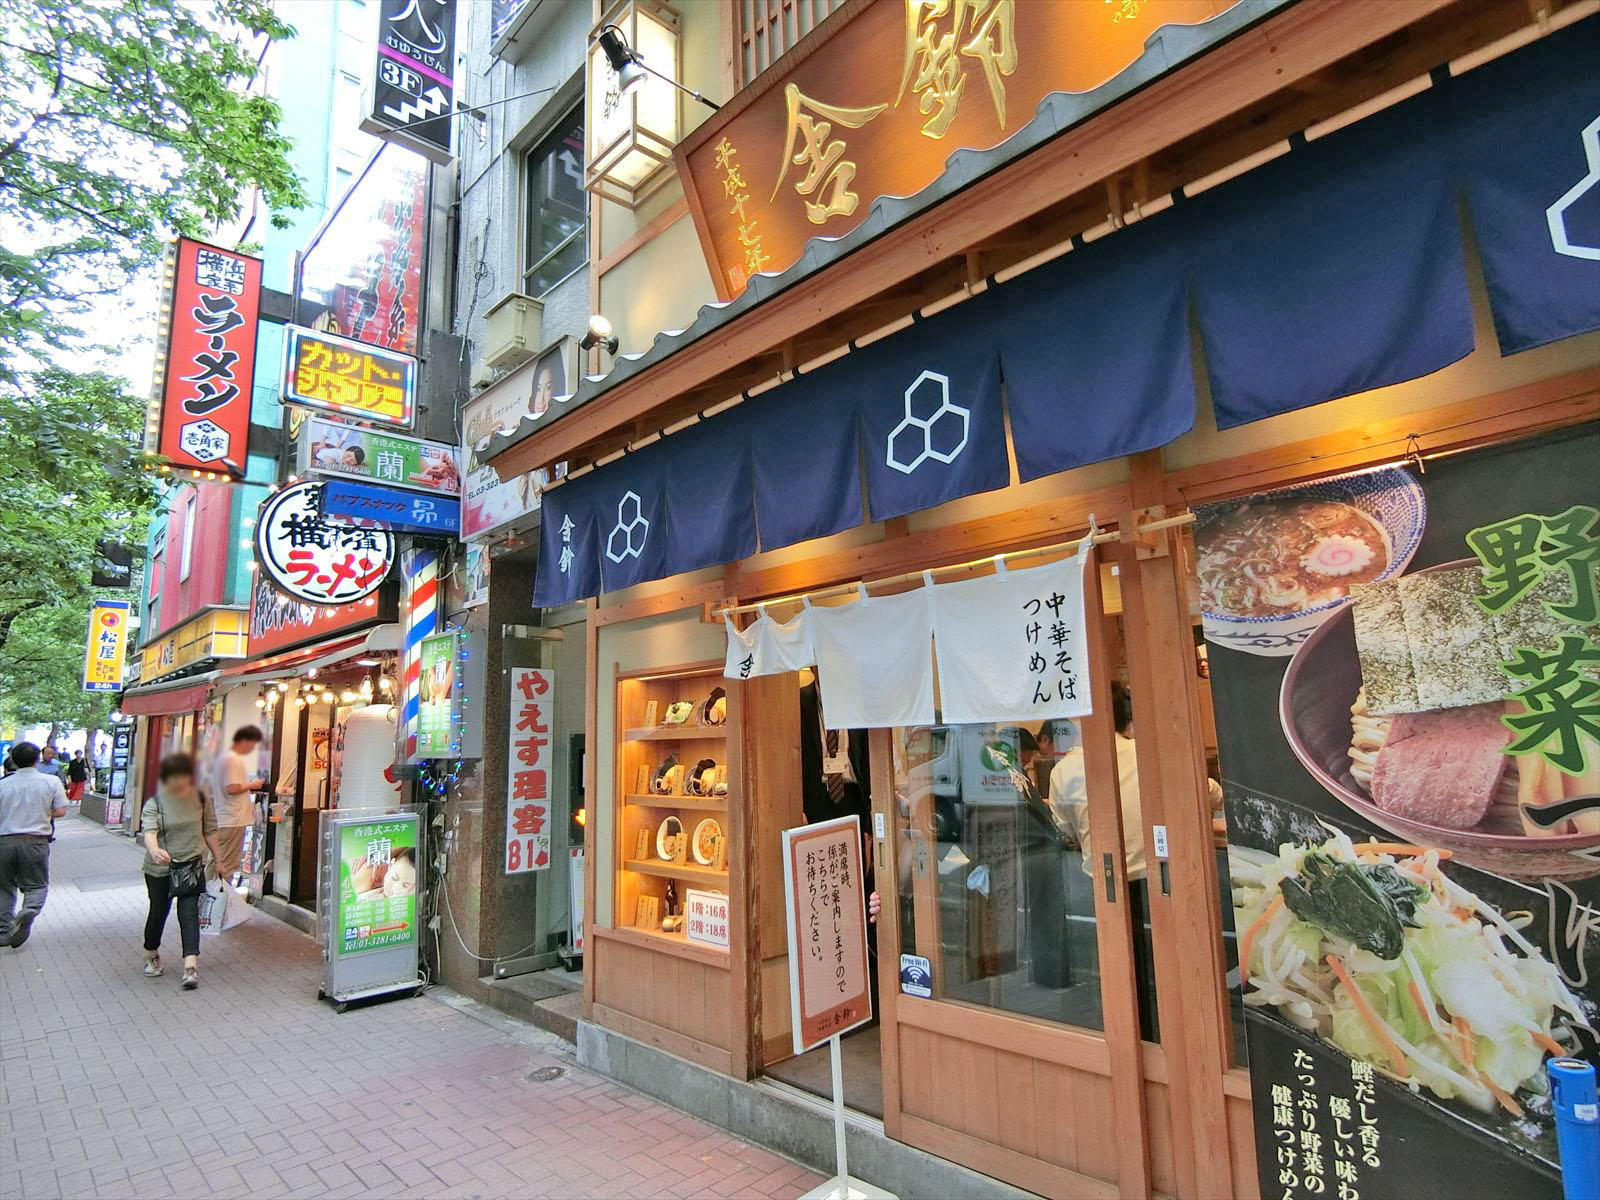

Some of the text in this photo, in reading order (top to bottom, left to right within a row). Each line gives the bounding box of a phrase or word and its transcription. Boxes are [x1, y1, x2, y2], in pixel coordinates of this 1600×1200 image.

[383, 62, 420, 92] 3F
[198, 251, 247, 281] 横浜
[181, 294, 244, 417] ラーメン
[297, 368, 403, 412] シャンプー
[185, 431, 225, 450] 壱角家
[371, 436, 417, 454] 香港式エステ
[376, 450, 404, 483] 蘭
[285, 549, 388, 596] ラーメン
[99, 629, 118, 659] 松屋
[1022, 598, 1052, 705] つけめん
[1045, 592, 1078, 702] 中華そば
[354, 823, 409, 838] 香港式エステ
[366, 837, 392, 866] 蘭
[508, 838, 534, 871] B1
[838, 841, 852, 889] 満席時、
[818, 848, 829, 906] こちらで
[806, 852, 824, 962] お待ちください。
[828, 845, 846, 993] 係がご案内しますので
[345, 931, 411, 951] Tel:03-3281-6400
[902, 956, 914, 965] Free
[1293, 1049, 1325, 1193] たっぷり野菜の
[1351, 1059, 1380, 1168] 鰹だし香る
[1329, 1095, 1359, 1200] 優しい味わ
